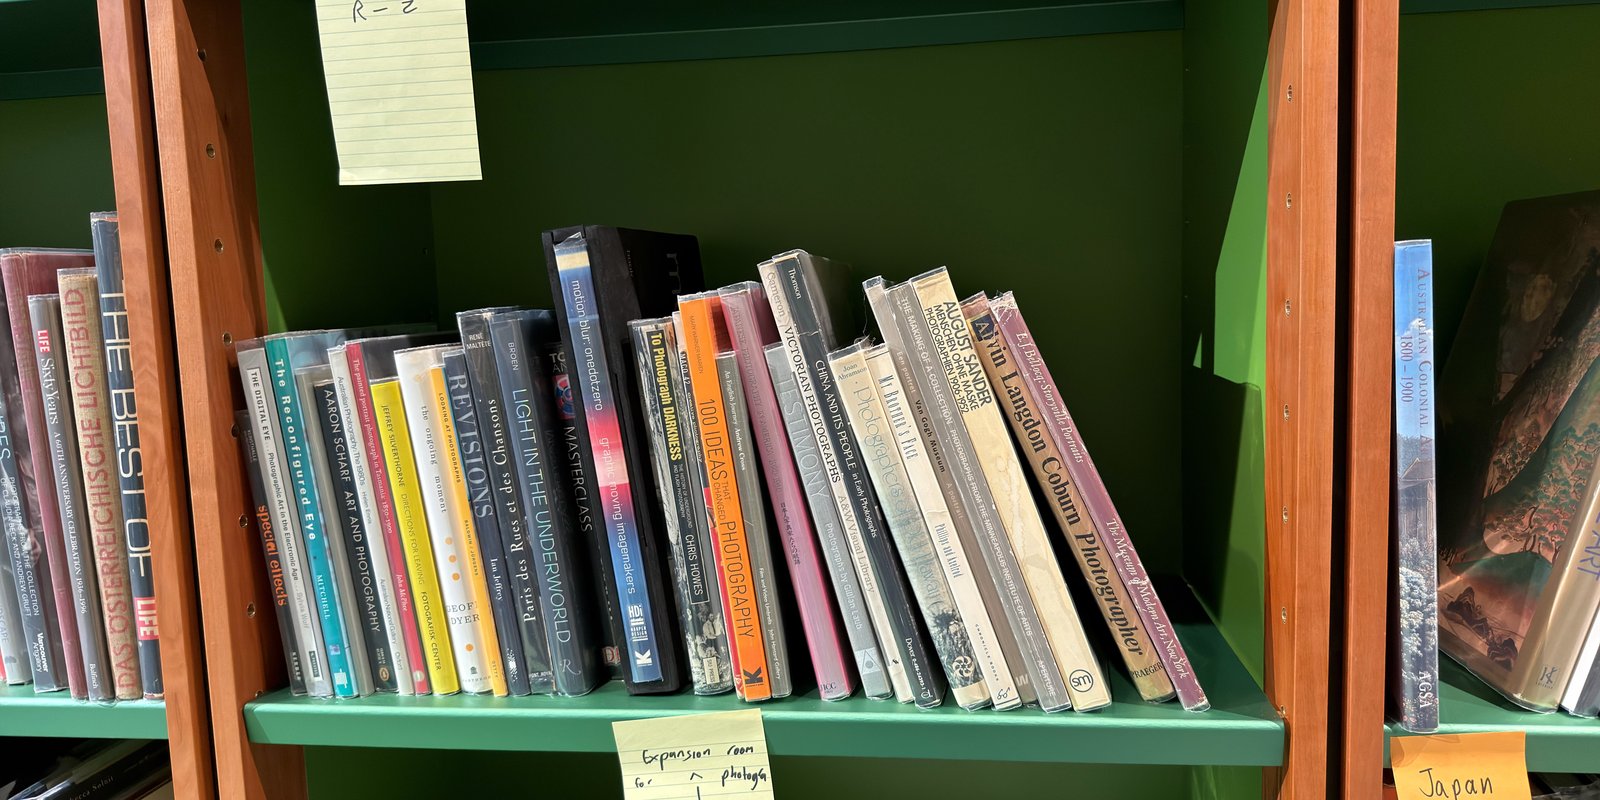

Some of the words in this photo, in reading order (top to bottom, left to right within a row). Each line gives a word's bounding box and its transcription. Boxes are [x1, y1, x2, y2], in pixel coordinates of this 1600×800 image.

[353, 0, 367, 23] R
[571, 280, 586, 317] motion
[765, 271, 787, 317] Cameron
[787, 268, 803, 299] Thomson
[899, 296, 911, 314] THE
[1417, 268, 1430, 353] AUSTRALIAN
[36, 329, 50, 352] LIFE
[63, 287, 99, 409] LICHTBILD
[579, 319, 592, 344] blur:
[650, 333, 662, 345] To
[905, 314, 925, 350] MAKING
[1015, 330, 1027, 341] E.
[1016, 339, 1031, 351] J.
[1400, 335, 1413, 361] 1800
[507, 342, 518, 370] BROEN
[896, 351, 906, 365] Een
[919, 350, 930, 363] OF
[923, 307, 956, 375] PHOTOGRAPHIEN
[948, 375, 970, 414] 1906-1952
[924, 364, 933, 372] A
[932, 304, 958, 352] MENSCHEN
[950, 352, 968, 379] OHNE
[960, 378, 980, 410] MASKE
[941, 298, 973, 354] AUGUST
[961, 352, 993, 406] SANDER
[1020, 346, 1049, 386] Bellocq:
[39, 357, 57, 391] Sixty
[251, 372, 259, 387] THE
[274, 358, 287, 387] The
[584, 347, 604, 410] onedotzero
[651, 347, 672, 405] Photograph
[724, 370, 731, 378] An
[724, 379, 735, 401] English
[814, 359, 832, 391] CHINA
[900, 366, 916, 393] portret
[1400, 376, 1413, 401] 1900
[45, 388, 62, 424] Years
[254, 389, 266, 423] DIGITAL
[783, 326, 812, 393] VICTORIAN
[805, 394, 841, 483] PHOTOGRAPHS
[824, 391, 839, 413] AND
[927, 372, 953, 424] COLLECTION
[1037, 382, 1069, 428] Storyville
[1417, 360, 1431, 426] COLONIAL
[421, 405, 429, 420] the
[512, 388, 536, 446] LIGHT
[698, 397, 718, 426] 100
[728, 402, 739, 424] Journey
[831, 413, 844, 429] ITS
[262, 425, 270, 440] EYE
[323, 388, 341, 433] AARON
[333, 436, 350, 482] SCHARF
[381, 404, 393, 432] JEFFREY
[388, 434, 405, 487] SILVERTHORNE
[423, 427, 437, 465] ongoing
[438, 392, 448, 423] LOOKING
[444, 424, 450, 432] AT
[447, 434, 460, 483] PHOTOGRAPHS
[447, 371, 494, 518] REVISIONS
[483, 398, 507, 466] Chansons
[662, 406, 681, 460] DARKNESS
[734, 427, 743, 451] Andrew
[775, 373, 829, 502] TESTIMONY
[836, 430, 856, 469] PEOPLE
[914, 399, 924, 414] Van
[919, 416, 933, 438] Gogh
[929, 439, 946, 472] Museum
[1060, 424, 1086, 464] Portraits
[279, 395, 311, 505] Reconfigured
[523, 447, 540, 466] IN
[597, 436, 615, 477] graphic
[704, 430, 728, 481] IDEAS
[738, 452, 746, 470] Cross
[266, 452, 282, 498] Photographic
[497, 472, 513, 494] des
[527, 469, 547, 506] THE
[562, 425, 594, 531] MASTERCLASS
[721, 481, 730, 501] THAT
[852, 479, 865, 497] Early
[974, 316, 1012, 368] Alvin
[997, 369, 1052, 454] Langdon
[1038, 454, 1086, 526] Coburn
[1071, 528, 1148, 659] Photographer
[9, 476, 24, 530] PHOTOGRAPHS
[343, 489, 356, 512] ART
[434, 475, 446, 513] moment
[504, 500, 516, 513] et
[606, 481, 623, 521] moving
[712, 482, 725, 520] CHANGED
[81, 418, 129, 634] ÖSTERREICHISCHE
[281, 519, 289, 531] the
[302, 513, 318, 540] Eye
[349, 515, 362, 542] AND
[400, 493, 415, 536] DIRECTIONS
[858, 496, 878, 538] Photographs
[1105, 517, 1120, 534] The
[19, 531, 28, 552] FROM
[284, 532, 296, 566] Electronic
[409, 538, 418, 554] FOR
[505, 519, 523, 552] Rues
[684, 534, 697, 560] CHRIS
[837, 493, 854, 524] A&W
[846, 522, 864, 554] Visual
[855, 554, 876, 593] Library
[23, 554, 31, 568] THE
[254, 504, 279, 555] special
[269, 559, 288, 606] effects
[413, 554, 424, 584] LEAVING
[489, 558, 498, 572] Ian
[513, 558, 529, 581] des
[613, 522, 637, 594] imagemakers
[1113, 534, 1140, 576] Museum
[289, 567, 299, 580] Age
[355, 546, 380, 632] PHOTOGRAPHY
[490, 573, 504, 601] Jeffrey
[534, 510, 572, 643] UNDERWORLD
[689, 563, 703, 595] HOWES
[719, 520, 755, 639] PHOTOGRAPHY
[1129, 573, 1145, 587] of
[26, 570, 39, 615] COLLECTION
[316, 574, 330, 619] MITCHELL
[518, 586, 536, 622] Paris
[1136, 582, 1161, 620] Modern
[135, 597, 158, 637] LIFE
[420, 591, 435, 639] FOTOGRAFISK
[430, 642, 441, 670] CENTER
[1152, 618, 1171, 640] Art,
[36, 632, 48, 672] Vancouver
[1162, 637, 1180, 659] New
[113, 643, 136, 689] DAS
[1036, 658, 1056, 696] APERTURE
[1171, 656, 1189, 679] York
[1418, 670, 1431, 707] AGSA
[642, 748, 711, 771] Expansion
[727, 745, 754, 756] room
[635, 777, 652, 788] for
[721, 765, 767, 790] photogra
[1419, 768, 1493, 800] Japan
